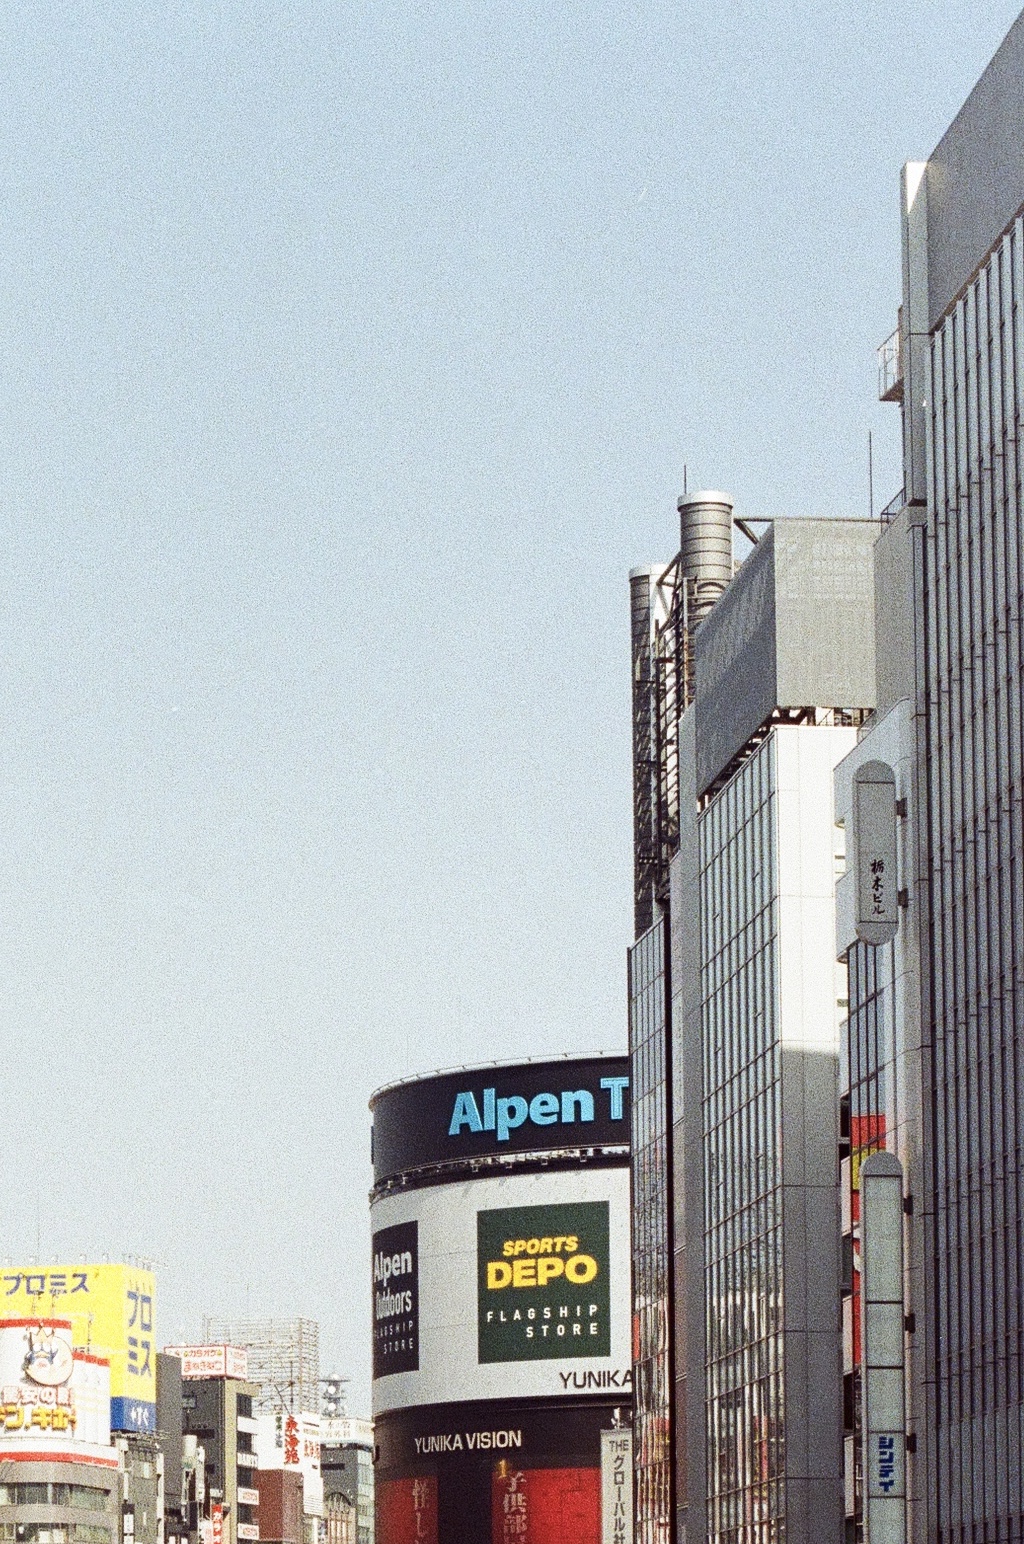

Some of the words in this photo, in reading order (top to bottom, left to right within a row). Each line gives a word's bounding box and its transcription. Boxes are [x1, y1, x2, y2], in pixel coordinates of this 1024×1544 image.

[448, 1087, 595, 1141] Alpen
[502, 1235, 579, 1257] SPORTS
[486, 1254, 598, 1290] DEPO
[3, 1272, 90, 1296] プロミス
[486, 1304, 598, 1323] FLAGSHIP
[525, 1323, 598, 1338] STORE
[414, 1432, 464, 1454] YUNIKA
[465, 1430, 523, 1451] VISION
[609, 1439, 630, 1451] THE
